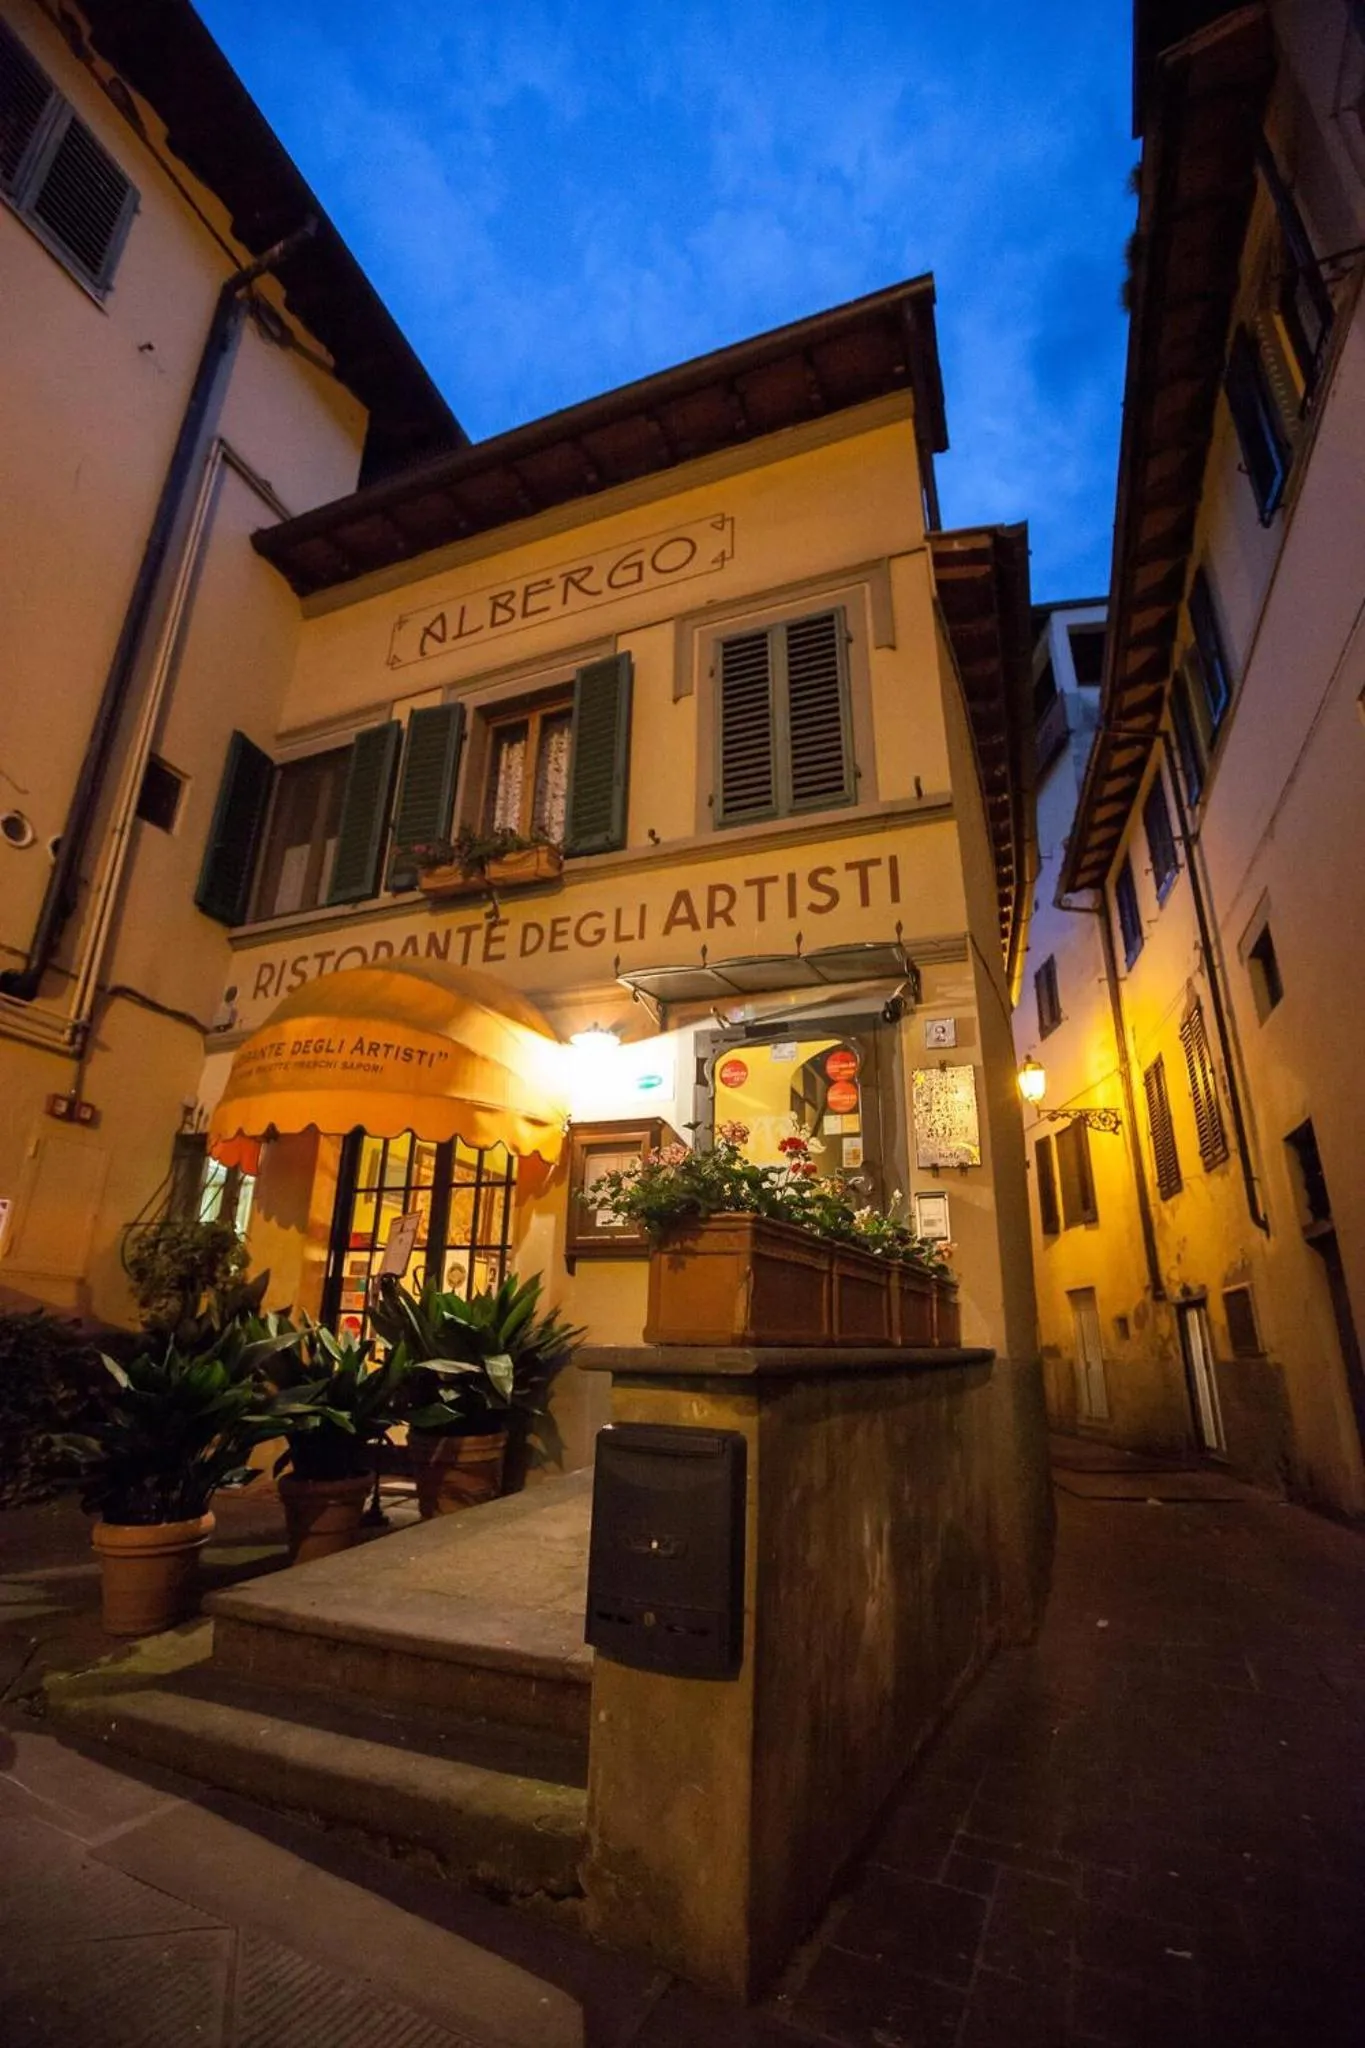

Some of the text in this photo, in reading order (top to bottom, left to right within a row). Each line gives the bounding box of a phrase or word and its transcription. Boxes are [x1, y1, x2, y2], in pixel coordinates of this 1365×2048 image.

[418, 536, 698, 657] ALBERGO
[518, 902, 648, 959] DEGLI
[661, 854, 901, 937] ARTISTI
[290, 1037, 345, 1055] DEGLI
